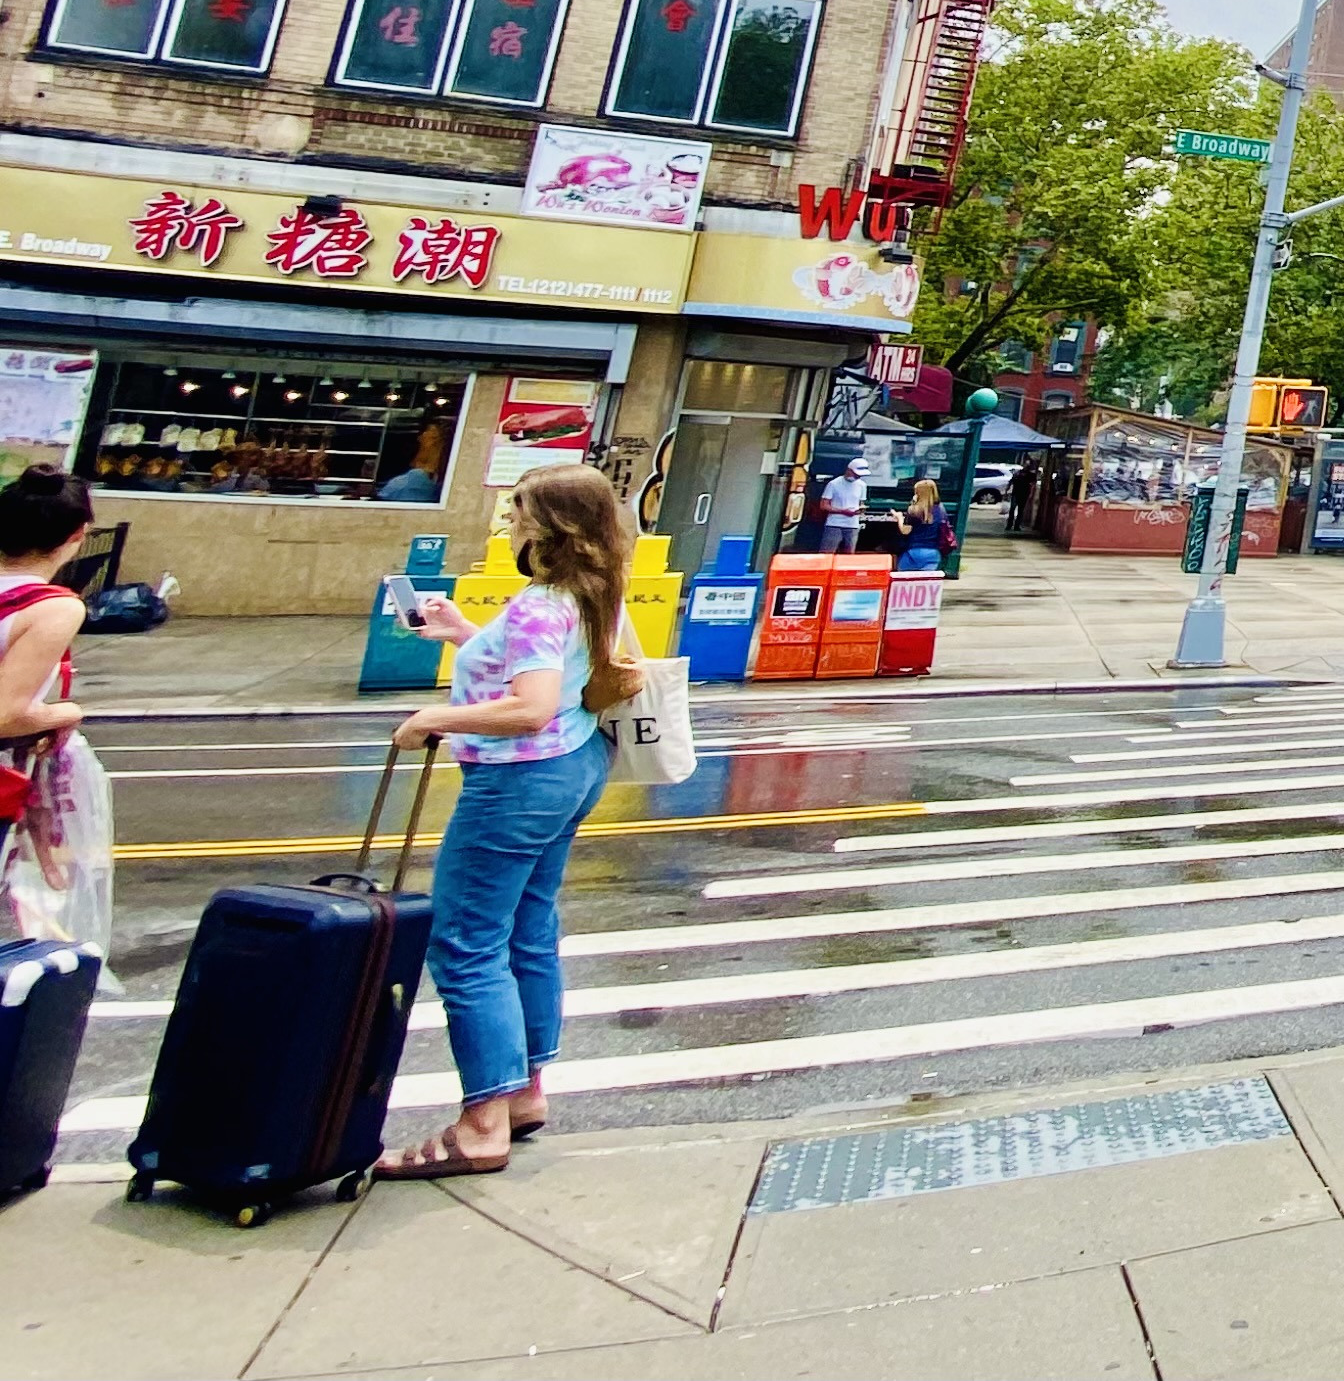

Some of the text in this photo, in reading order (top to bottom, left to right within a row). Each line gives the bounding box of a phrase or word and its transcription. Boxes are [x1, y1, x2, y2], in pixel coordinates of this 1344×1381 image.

[1177, 133, 1270, 162] E Broadway
[798, 184, 897, 242] Wu
[20, 232, 113, 262] Broadway
[128, 191, 500, 289] 新糖潮
[870, 346, 905, 382] ATM
[890, 584, 942, 609] INDY
